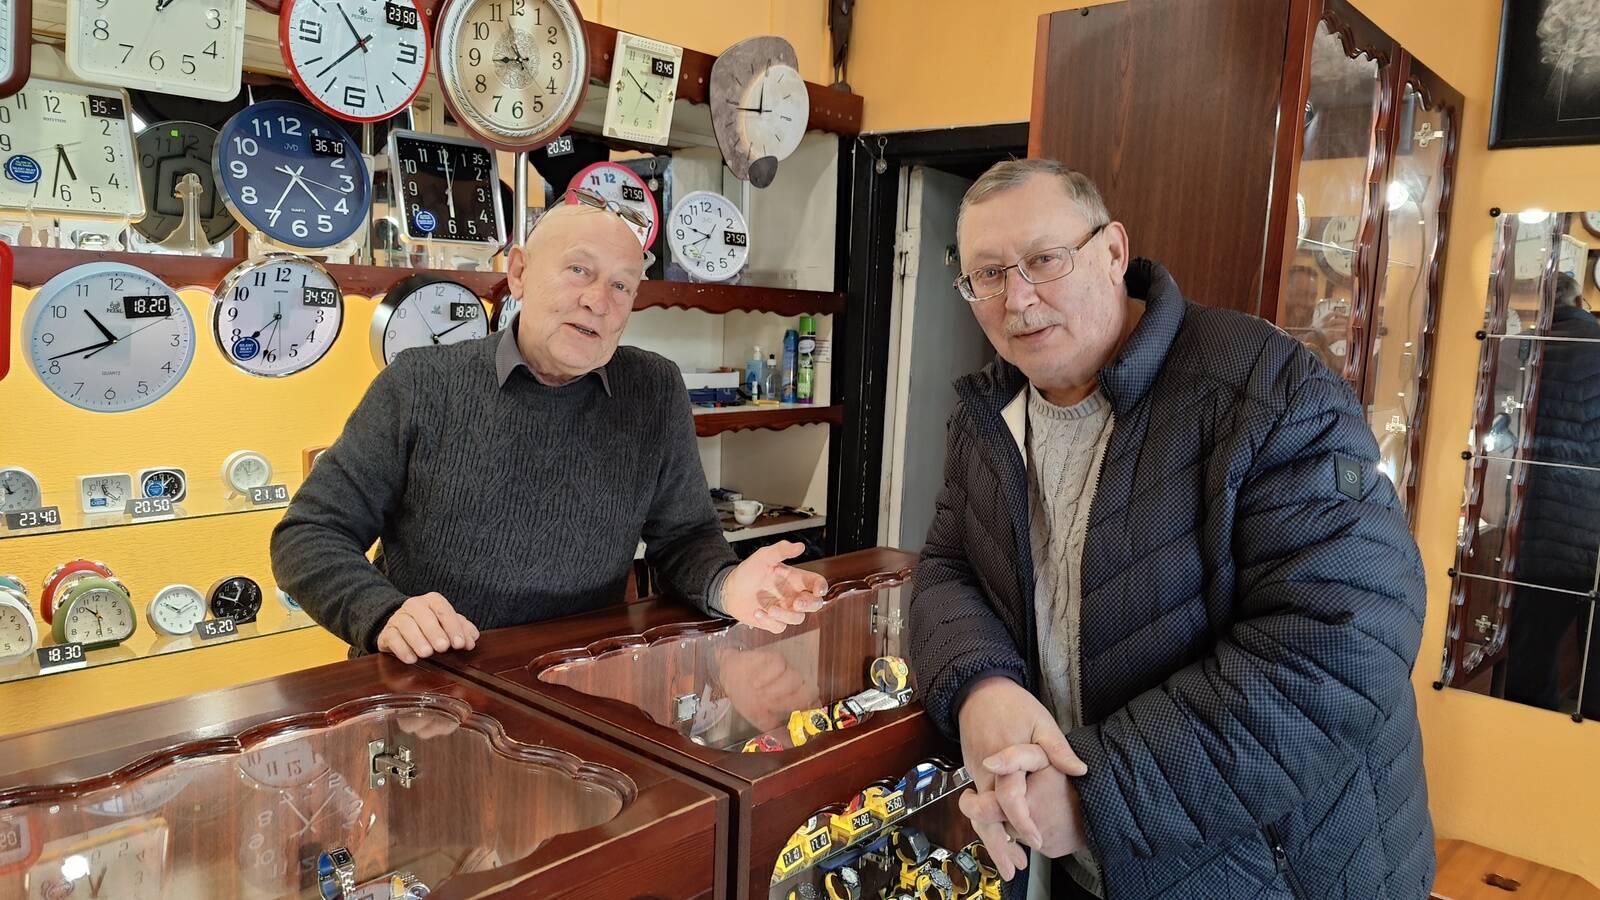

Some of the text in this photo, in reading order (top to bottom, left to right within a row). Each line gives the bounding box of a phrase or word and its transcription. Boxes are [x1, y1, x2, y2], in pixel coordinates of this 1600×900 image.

[389, 6, 416, 25] 23.50
[489, 4, 503, 23] 11
[509, 0, 525, 17] 12
[206, 9, 221, 30] 3
[534, 8, 542, 26] 1
[92, 19, 110, 41] 8
[299, 19, 323, 44] 9
[473, 22, 490, 41] 10
[547, 26, 558, 45] 2
[119, 44, 134, 64] 7
[202, 40, 219, 59] 4
[397, 42, 418, 65] 3
[630, 51, 636, 61] 11
[150, 50, 165, 71] 6
[181, 55, 196, 75] 5
[469, 48, 481, 67] 9
[552, 52, 563, 70] 3
[643, 54, 650, 64] 12
[656, 61, 673, 75] 13.45
[475, 74, 487, 93] 8
[545, 76, 558, 95] 4
[16, 93, 28, 110] 11
[44, 95, 62, 114] 12
[344, 86, 366, 108] 6
[492, 96, 503, 113] 7
[533, 96, 544, 112] 5
[80, 101, 87, 118] 1
[512, 101, 524, 119] 6
[100, 119, 112, 136] 2
[252, 118, 272, 139] 11
[278, 116, 302, 137] 12
[0, 134, 12, 152] 9
[234, 137, 259, 157] 10
[315, 139, 344, 155] 36.70
[548, 140, 571, 155] 20.50
[104, 146, 115, 163] 3
[418, 148, 428, 163] 11
[461, 154, 467, 168] 1
[230, 160, 248, 179] 9
[404, 159, 417, 174] 10
[108, 173, 120, 189] 4
[474, 168, 483, 182] 2
[591, 176, 600, 186] 11
[604, 173, 616, 184] 12
[340, 175, 355, 193] 3
[409, 182, 418, 196] 9
[60, 184, 72, 202] 6
[90, 186, 102, 204] 5
[241, 186, 258, 205] 8
[477, 189, 485, 203] 3
[623, 188, 643, 200] 27.50
[334, 198, 350, 216] 4
[689, 205, 698, 216] 11
[700, 202, 712, 213] 12
[717, 208, 722, 218] 1
[264, 209, 282, 227] 7
[318, 215, 333, 233] 5
[480, 210, 488, 224] 4
[680, 214, 692, 225] 10
[726, 219, 734, 229] 2
[292, 220, 309, 238] 6
[448, 220, 457, 234] 6
[468, 221, 477, 235] 5
[676, 229, 685, 240] 9
[726, 233, 746, 245] 27.50
[728, 249, 736, 258] 4
[707, 261, 715, 272] 6
[720, 258, 728, 269] 5
[253, 272, 267, 287] 11
[275, 268, 292, 282] 12
[301, 275, 307, 288] 1
[76, 285, 89, 297] 11
[109, 278, 124, 292] 12
[436, 286, 445, 297] 12
[234, 286, 249, 301] 10
[305, 289, 335, 305] 34.50
[415, 292, 422, 301] 11
[51, 305, 67, 319] 10
[134, 298, 167, 314] 18.20
[456, 306, 478, 318] 18.20
[228, 307, 238, 323] 9
[315, 309, 325, 324] 3
[396, 308, 407, 320] 10
[42, 333, 55, 346] 9
[170, 334, 180, 347] 3
[231, 328, 241, 343] 8
[306, 329, 316, 343] 4
[388, 330, 397, 340] 9
[267, 349, 277, 363] 6
[289, 344, 299, 358] 5
[49, 360, 61, 375] 8
[161, 361, 172, 374] 4
[74, 382, 85, 396] 7
[104, 387, 116, 400] 6
[137, 381, 149, 394] 5
[255, 488, 286, 502] 21.10
[135, 499, 170, 514] 20.50
[20, 510, 57, 526] 23.40
[206, 620, 234, 635] 15.20
[49, 645, 82, 662] 18.30
